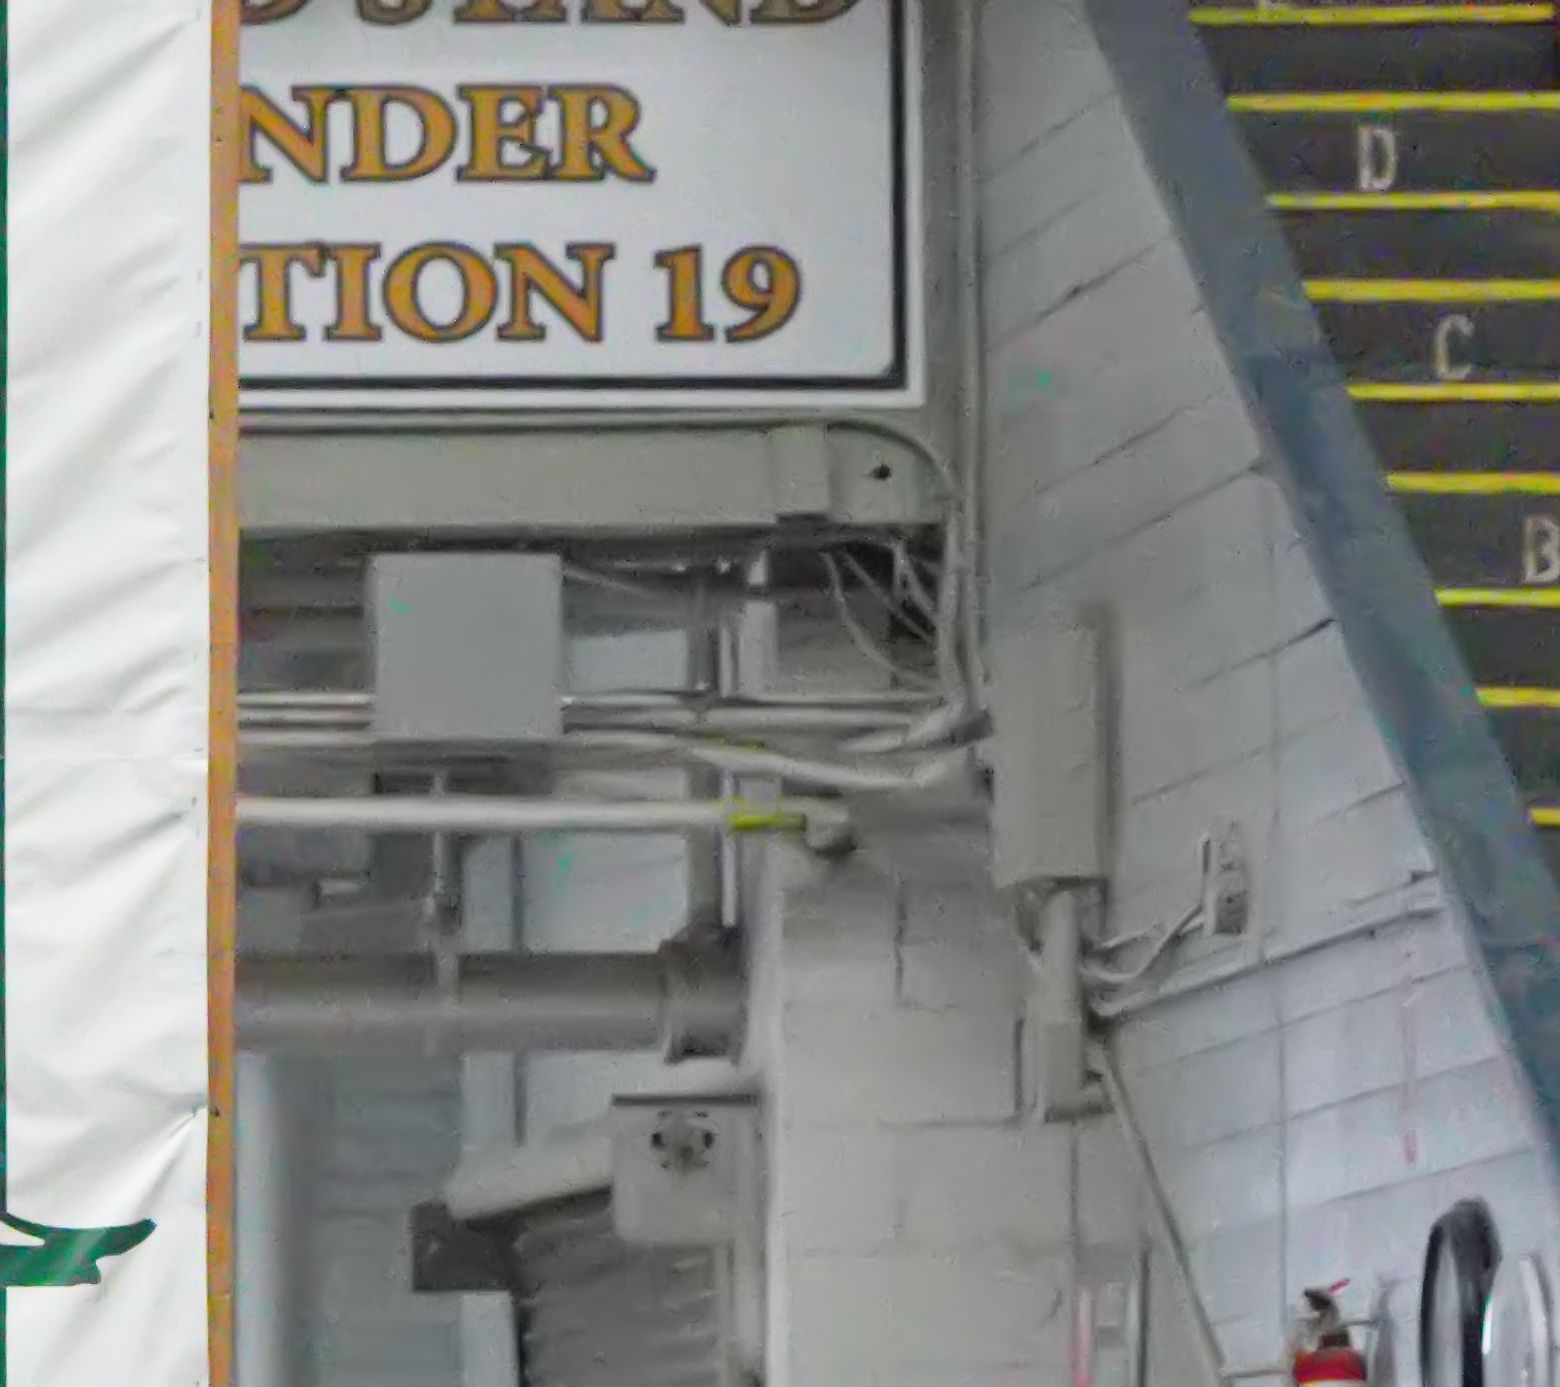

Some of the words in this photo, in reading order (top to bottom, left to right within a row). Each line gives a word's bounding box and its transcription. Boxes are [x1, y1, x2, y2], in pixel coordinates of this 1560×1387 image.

[239, 84, 656, 183] NDER
[1357, 125, 1398, 191] D
[239, 242, 616, 343] TION
[654, 244, 802, 344] 19
[1434, 315, 1476, 381] C
